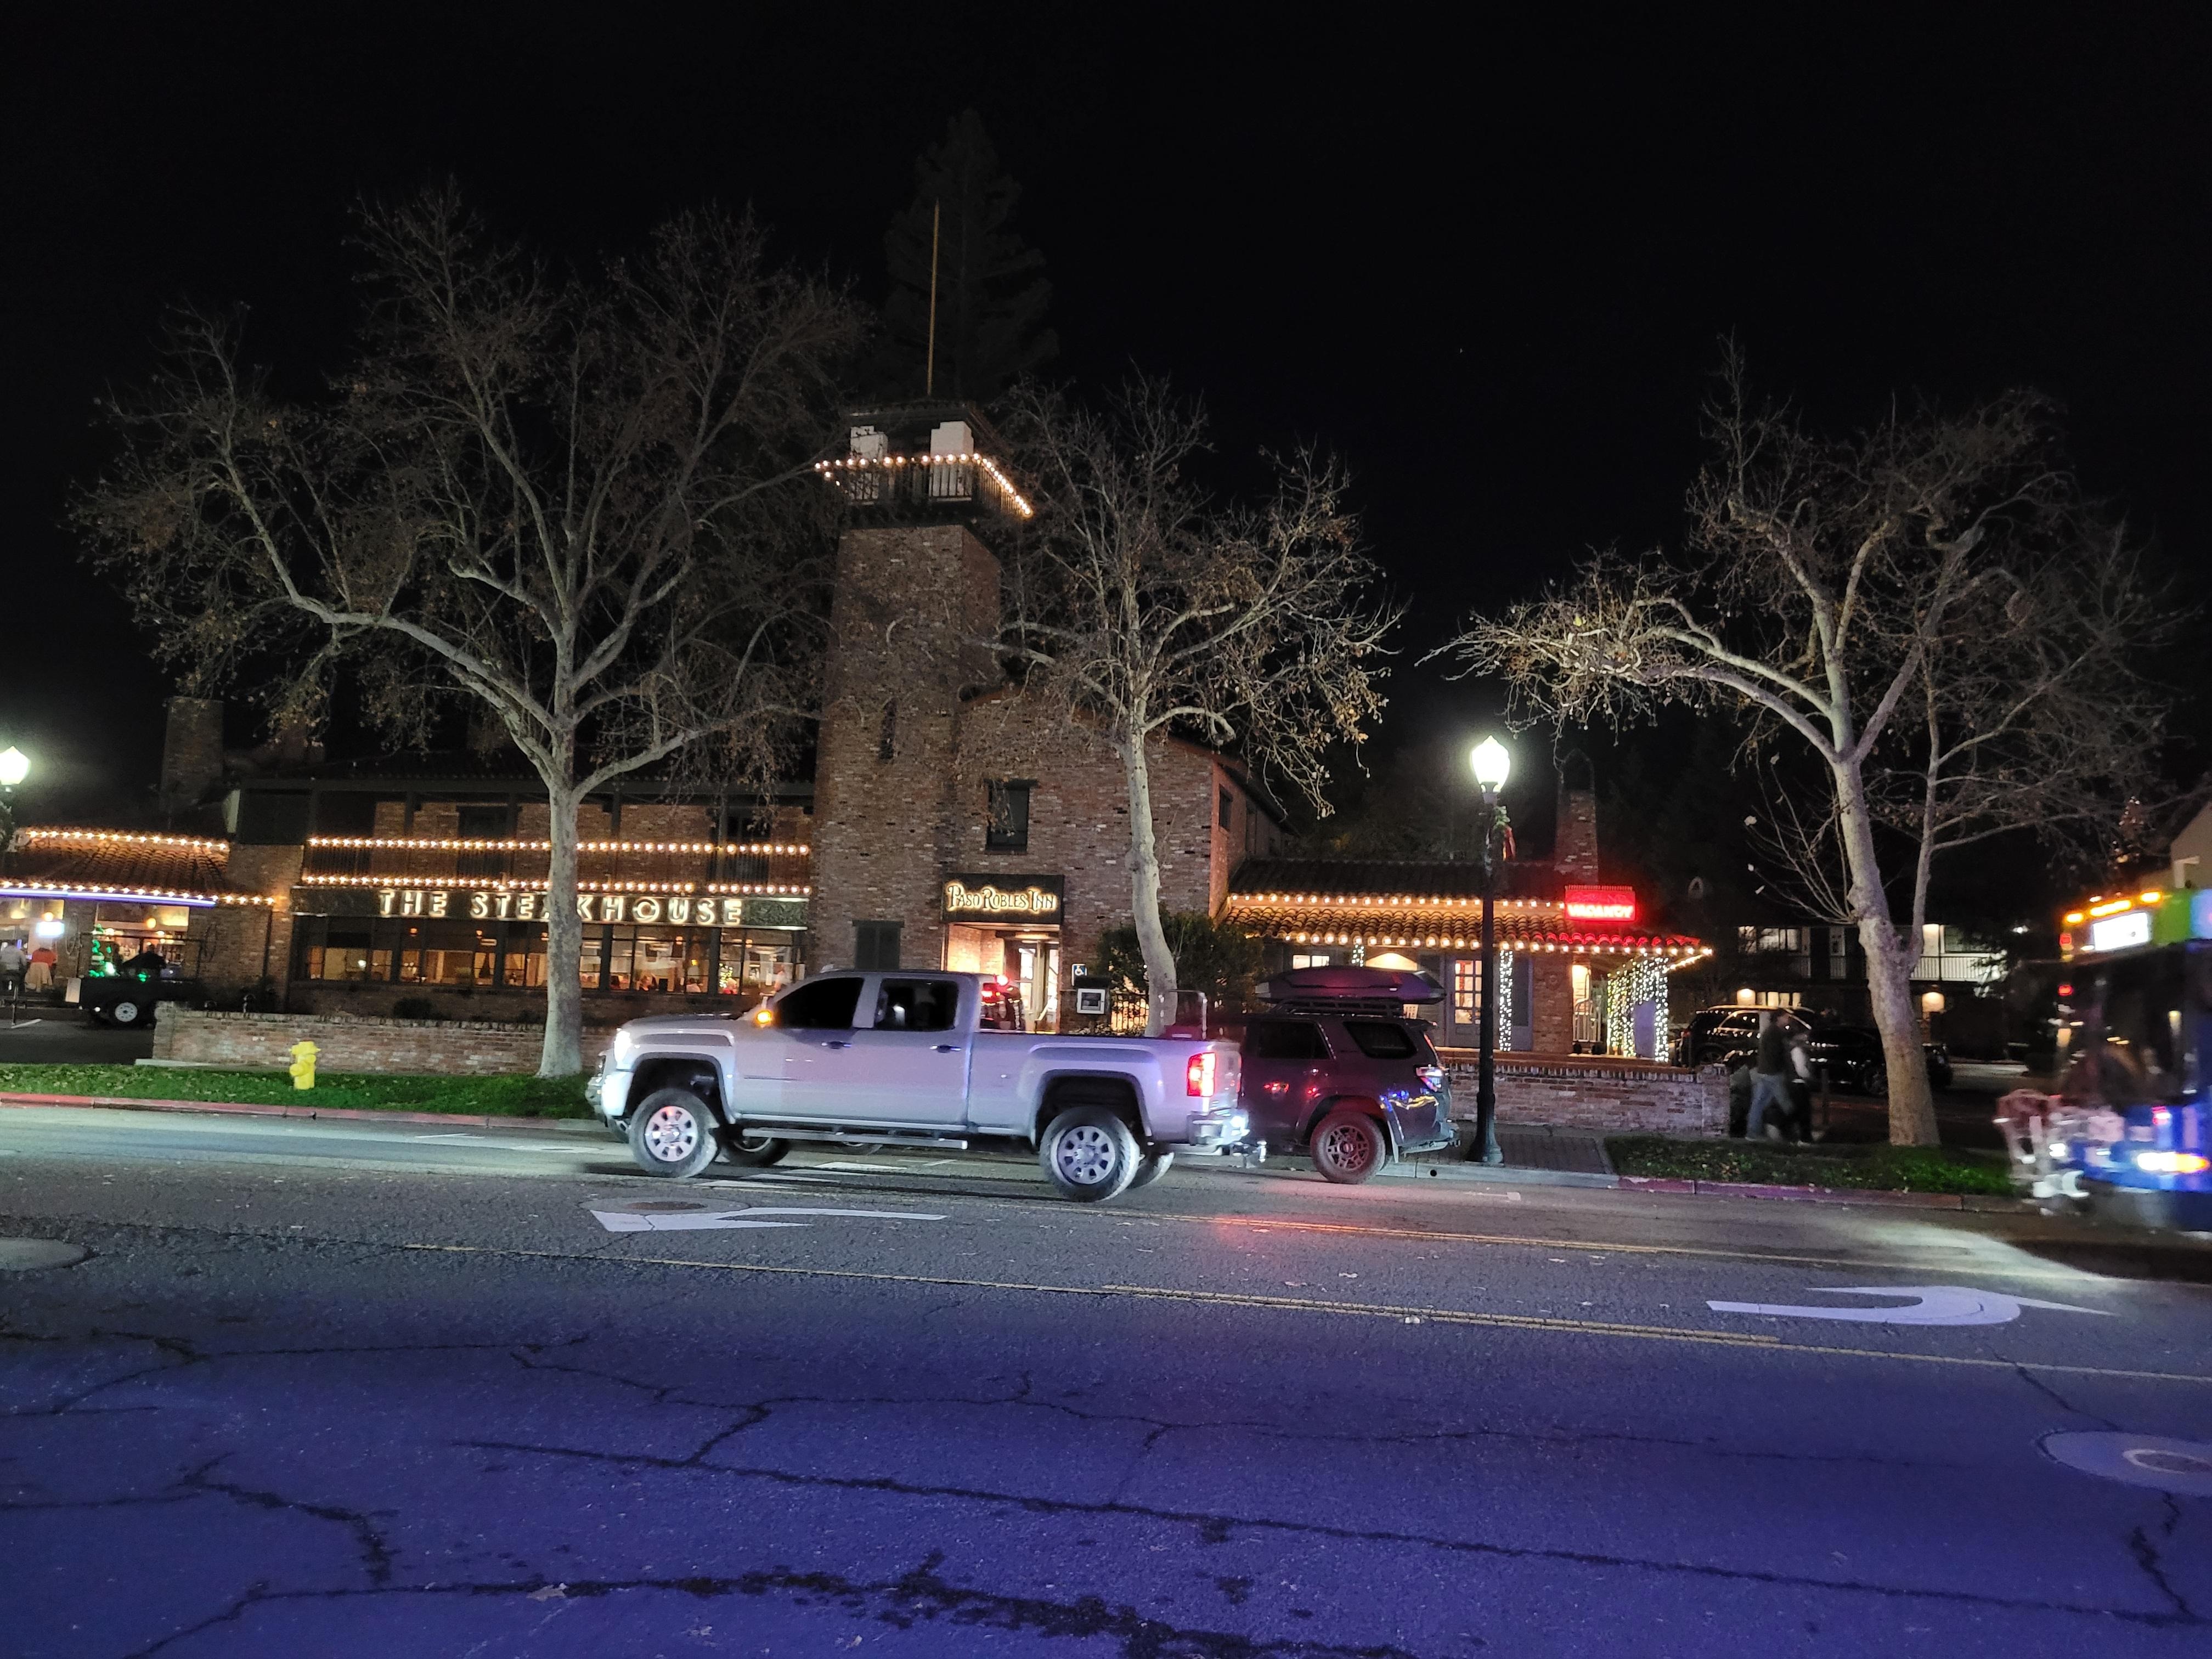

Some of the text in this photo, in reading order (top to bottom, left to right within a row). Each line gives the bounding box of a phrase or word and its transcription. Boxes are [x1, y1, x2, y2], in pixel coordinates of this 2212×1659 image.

[379, 888, 448, 918] THE
[947, 884, 1054, 912] PASO ROBLES INN
[1567, 904, 1634, 918] VACANCY
